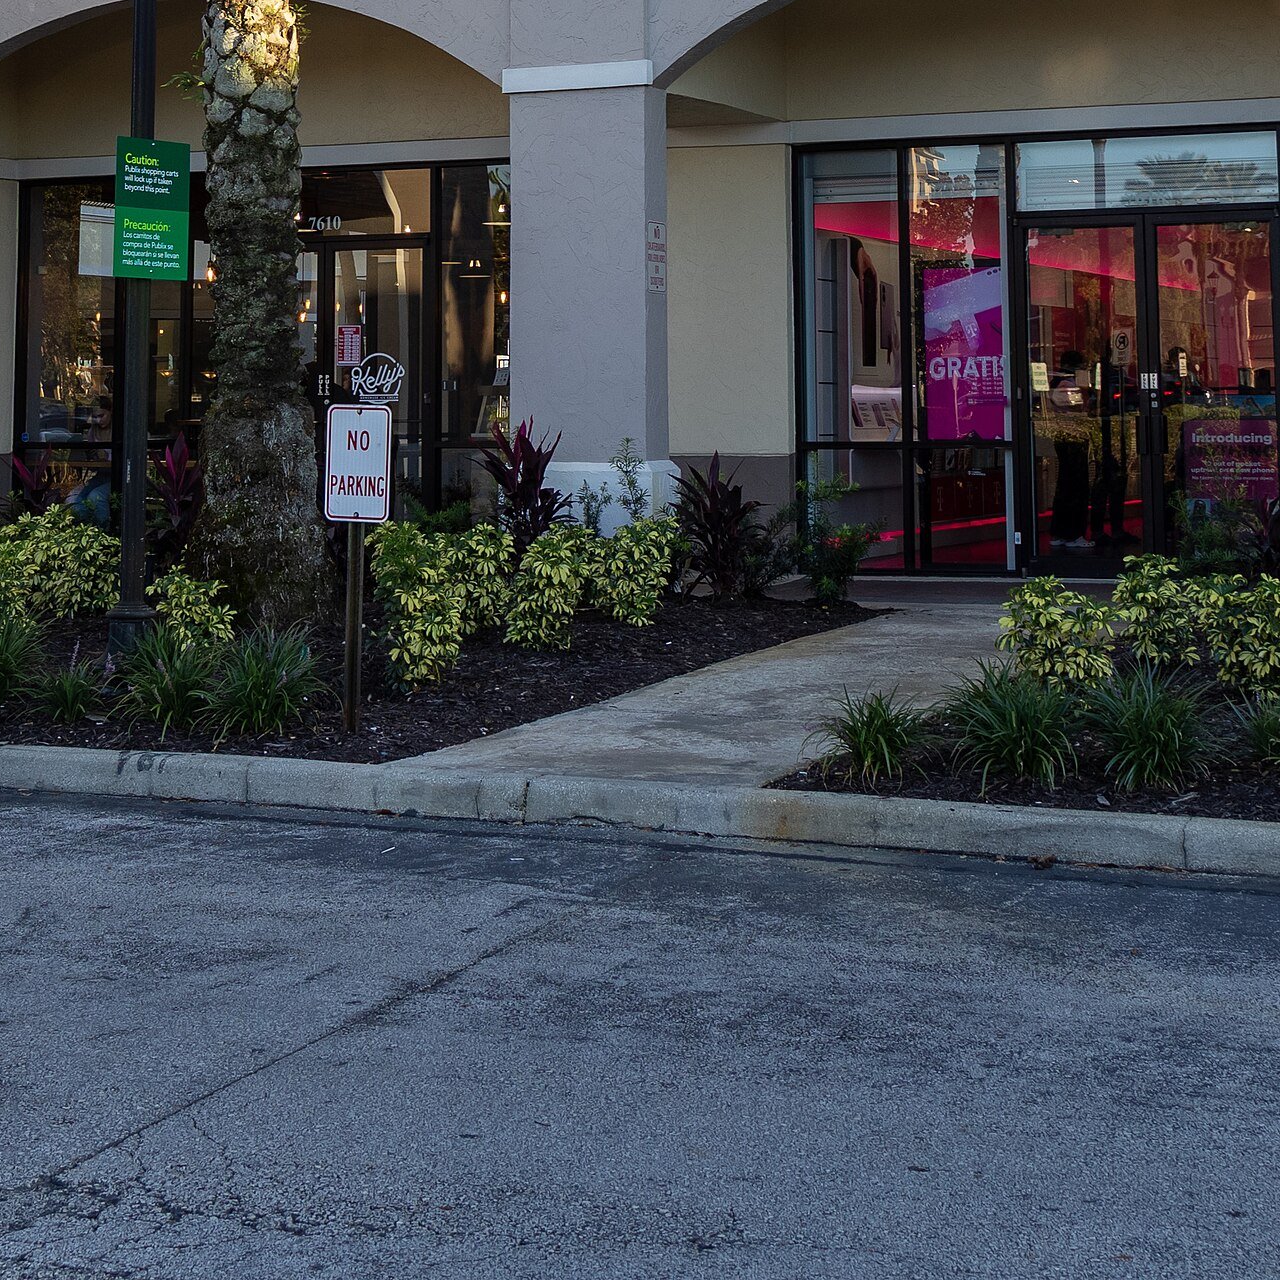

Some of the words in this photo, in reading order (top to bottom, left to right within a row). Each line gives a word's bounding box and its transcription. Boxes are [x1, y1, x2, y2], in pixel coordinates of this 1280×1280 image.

[125, 153, 159, 166] Caution:
[125, 165, 140, 173] Publix
[141, 167, 165, 177] shopping
[134, 175, 145, 183] lock
[124, 183, 144, 192] beyond
[155, 186, 170, 194] point.
[124, 219, 171, 231] Precaución:
[309, 216, 341, 231] 7610
[123, 249, 152, 259] bloquearán
[165, 251, 179, 259] llevan
[351, 363, 405, 395] Kelly's
[347, 430, 370, 451] NO
[1192, 433, 1272, 445] Introducing
[330, 475, 384, 497] PARKING
